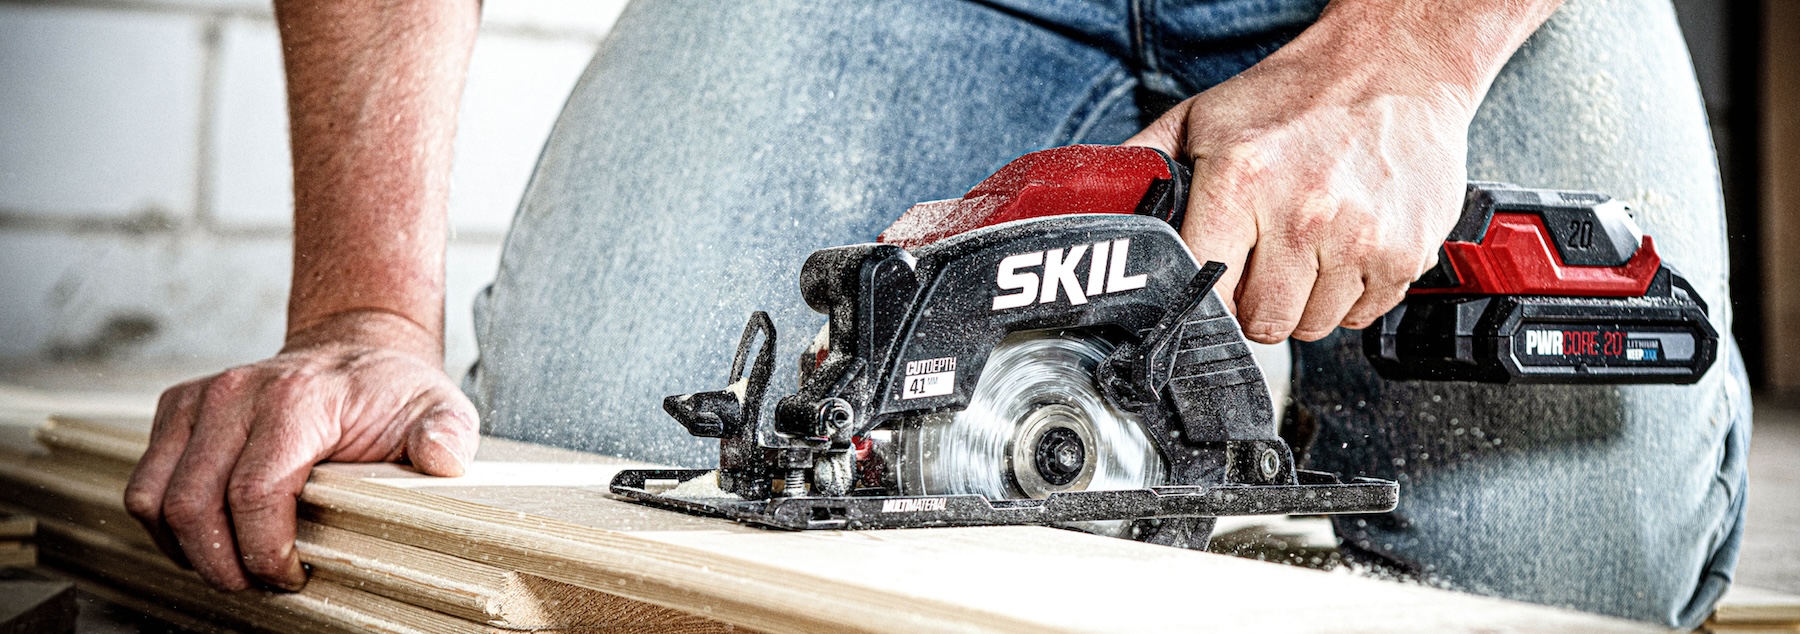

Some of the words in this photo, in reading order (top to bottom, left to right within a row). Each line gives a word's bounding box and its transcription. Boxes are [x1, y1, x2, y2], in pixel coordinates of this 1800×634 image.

[1567, 220, 1593, 249] 20
[992, 238, 1148, 311] SKIL
[1526, 330, 1599, 356] PWRCORE
[1626, 339, 1659, 349] LITHIUM
[905, 356, 957, 376] CUTDEPTH
[909, 377, 926, 395] 41
[881, 498, 947, 513] MULTIMATERIAL
